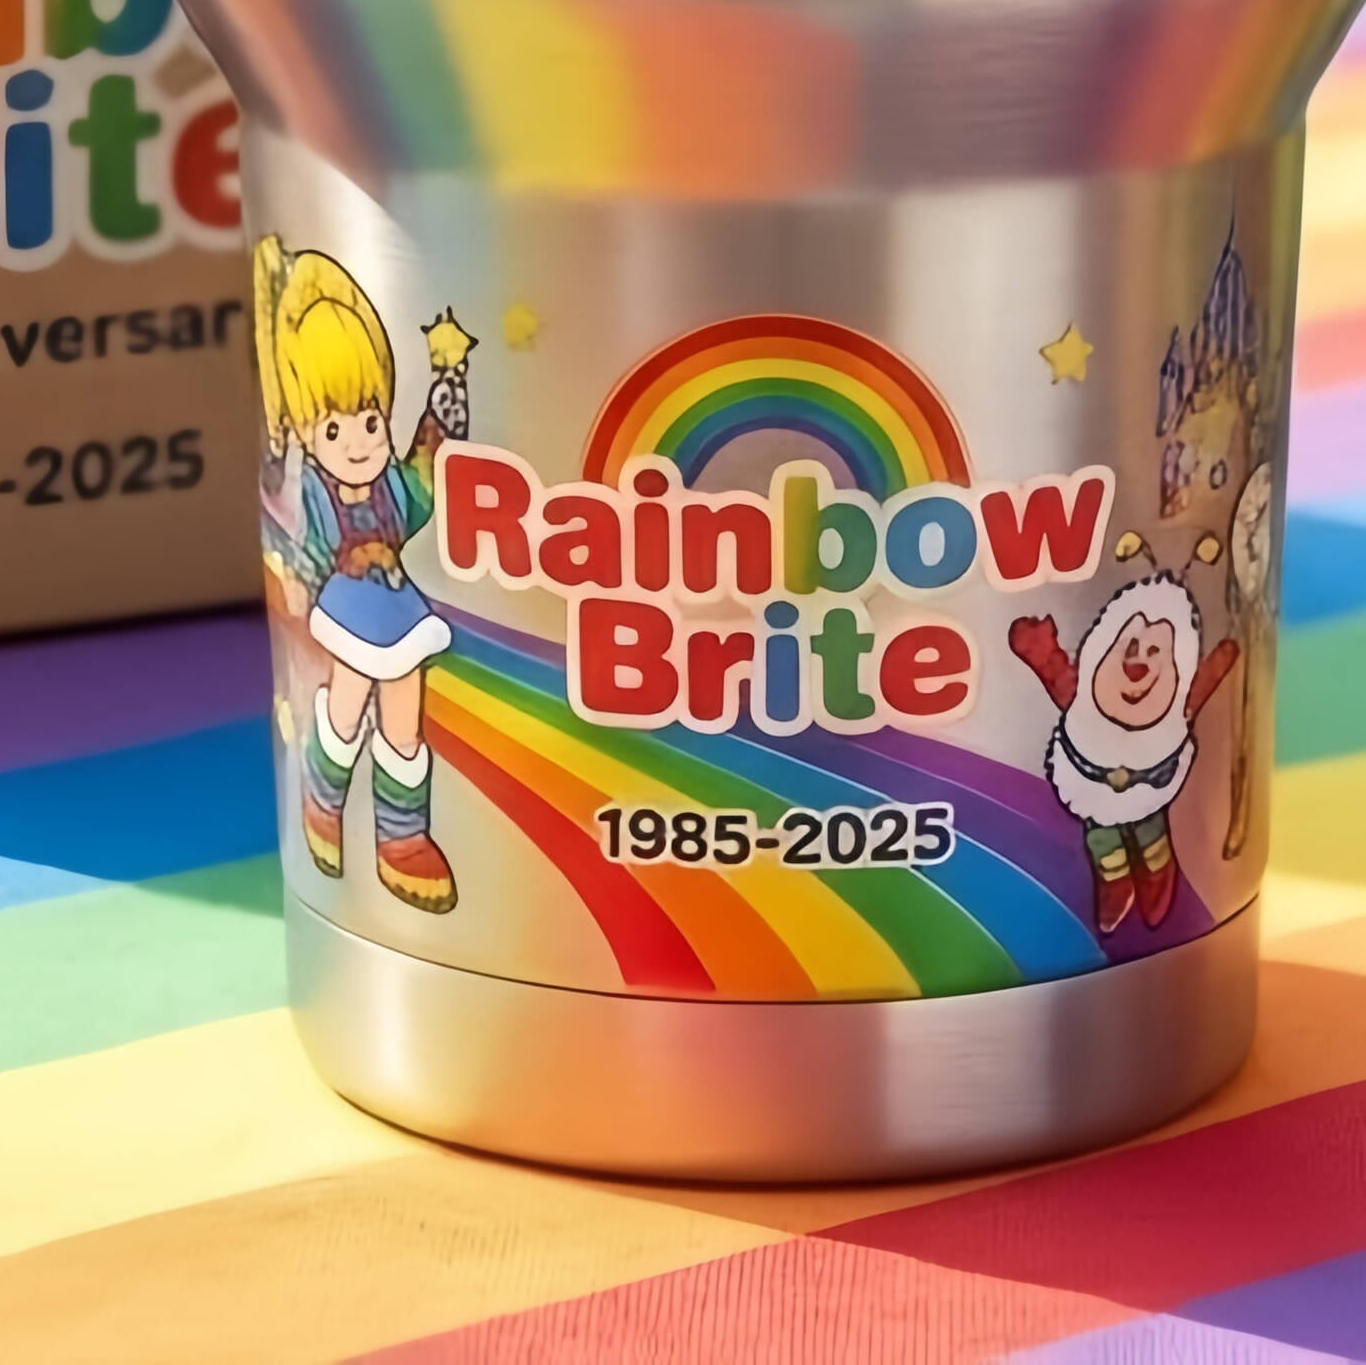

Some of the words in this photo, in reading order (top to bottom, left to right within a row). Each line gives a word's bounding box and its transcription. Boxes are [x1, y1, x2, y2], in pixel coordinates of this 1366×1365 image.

[443, 451, 1108, 596] Rainbow
[577, 596, 974, 725] Brite
[596, 805, 955, 867] 1985-2025
